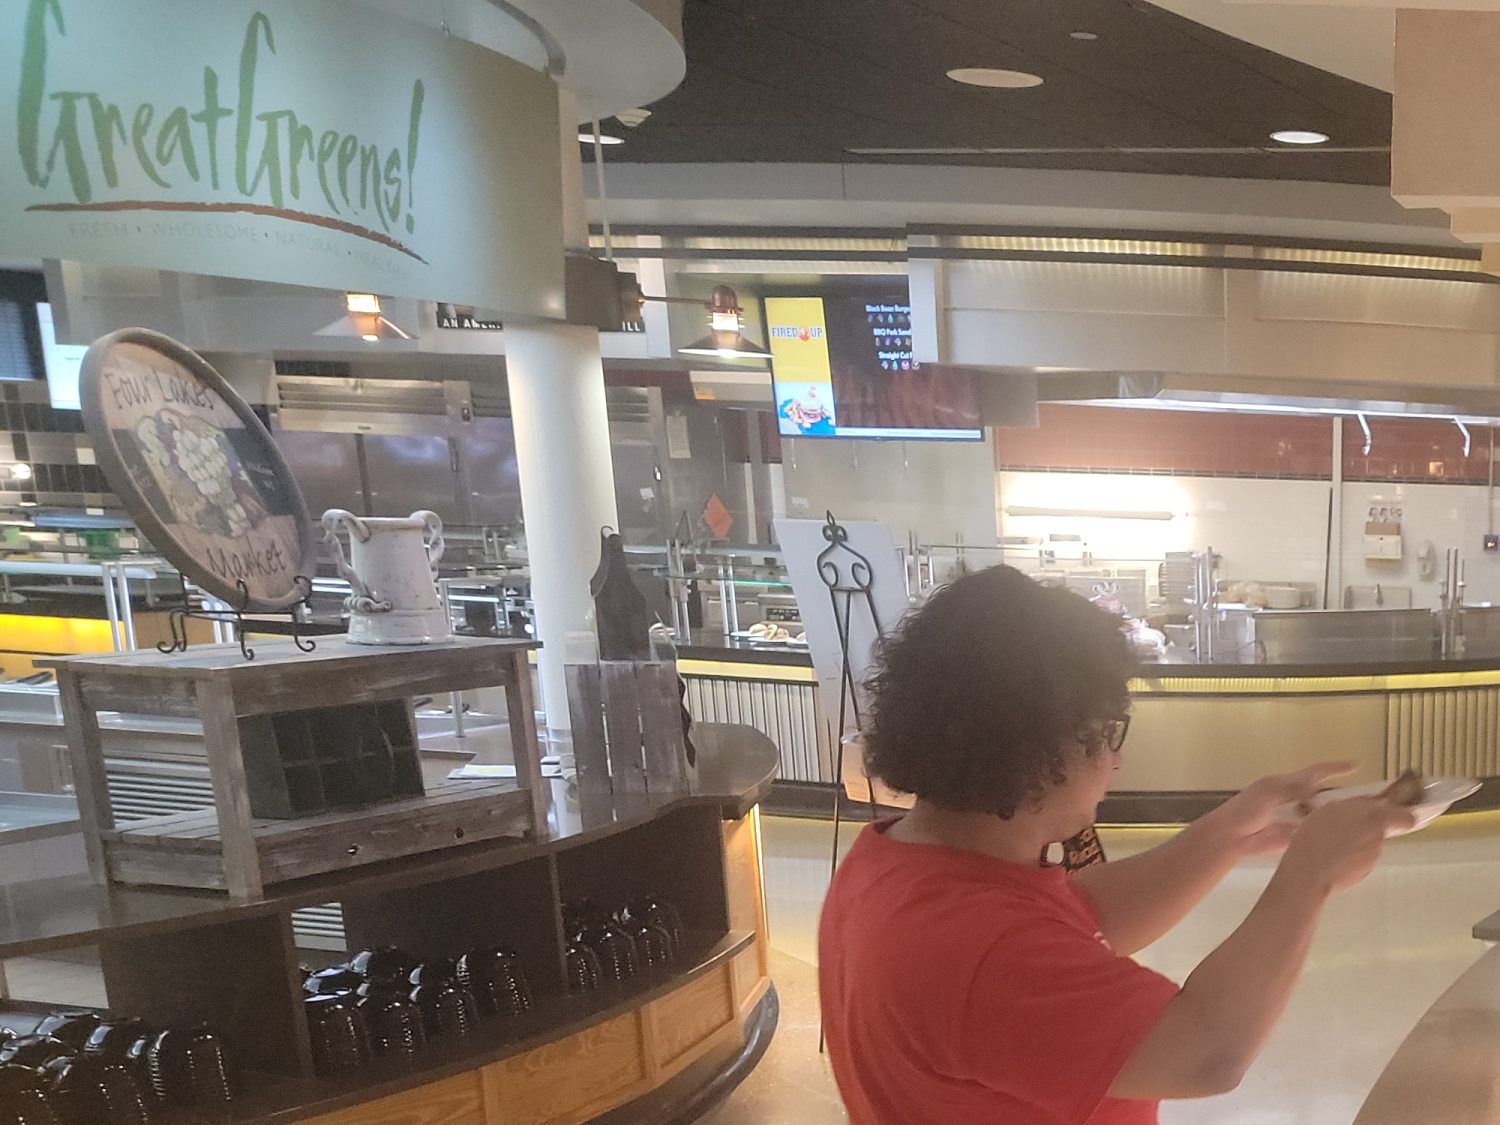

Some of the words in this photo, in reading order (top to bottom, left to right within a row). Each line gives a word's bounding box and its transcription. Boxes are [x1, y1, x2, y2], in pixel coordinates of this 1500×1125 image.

[69, 221, 128, 239] FRESH
[150, 220, 258, 242] WHOLESOME
[275, 230, 342, 256] NATURAL
[771, 327, 798, 338] FIRED
[810, 327, 823, 338] UP
[104, 372, 152, 410] Four
[153, 366, 215, 411] Lakes
[205, 534, 288, 578] Market
